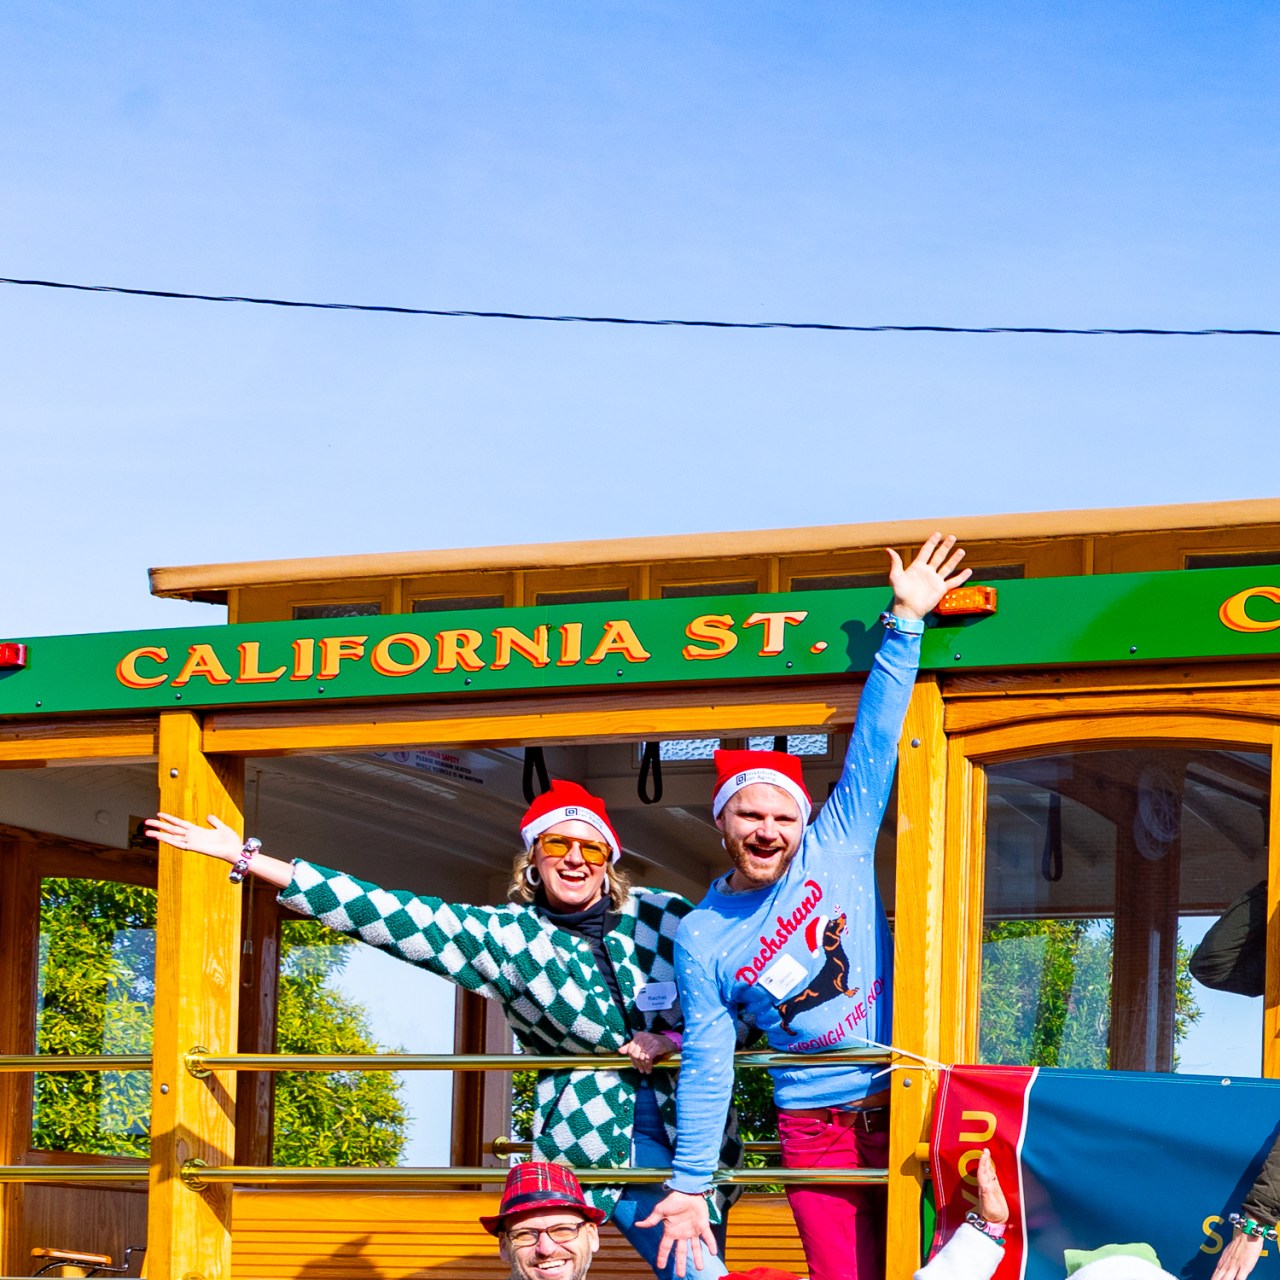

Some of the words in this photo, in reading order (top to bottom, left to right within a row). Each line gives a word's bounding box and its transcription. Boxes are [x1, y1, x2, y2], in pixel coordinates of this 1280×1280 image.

[116, 619, 652, 690] CALIFORNIA
[682, 610, 828, 661] ST.
[735, 879, 823, 986] Dachshund
[844, 1002, 868, 1031] THE
